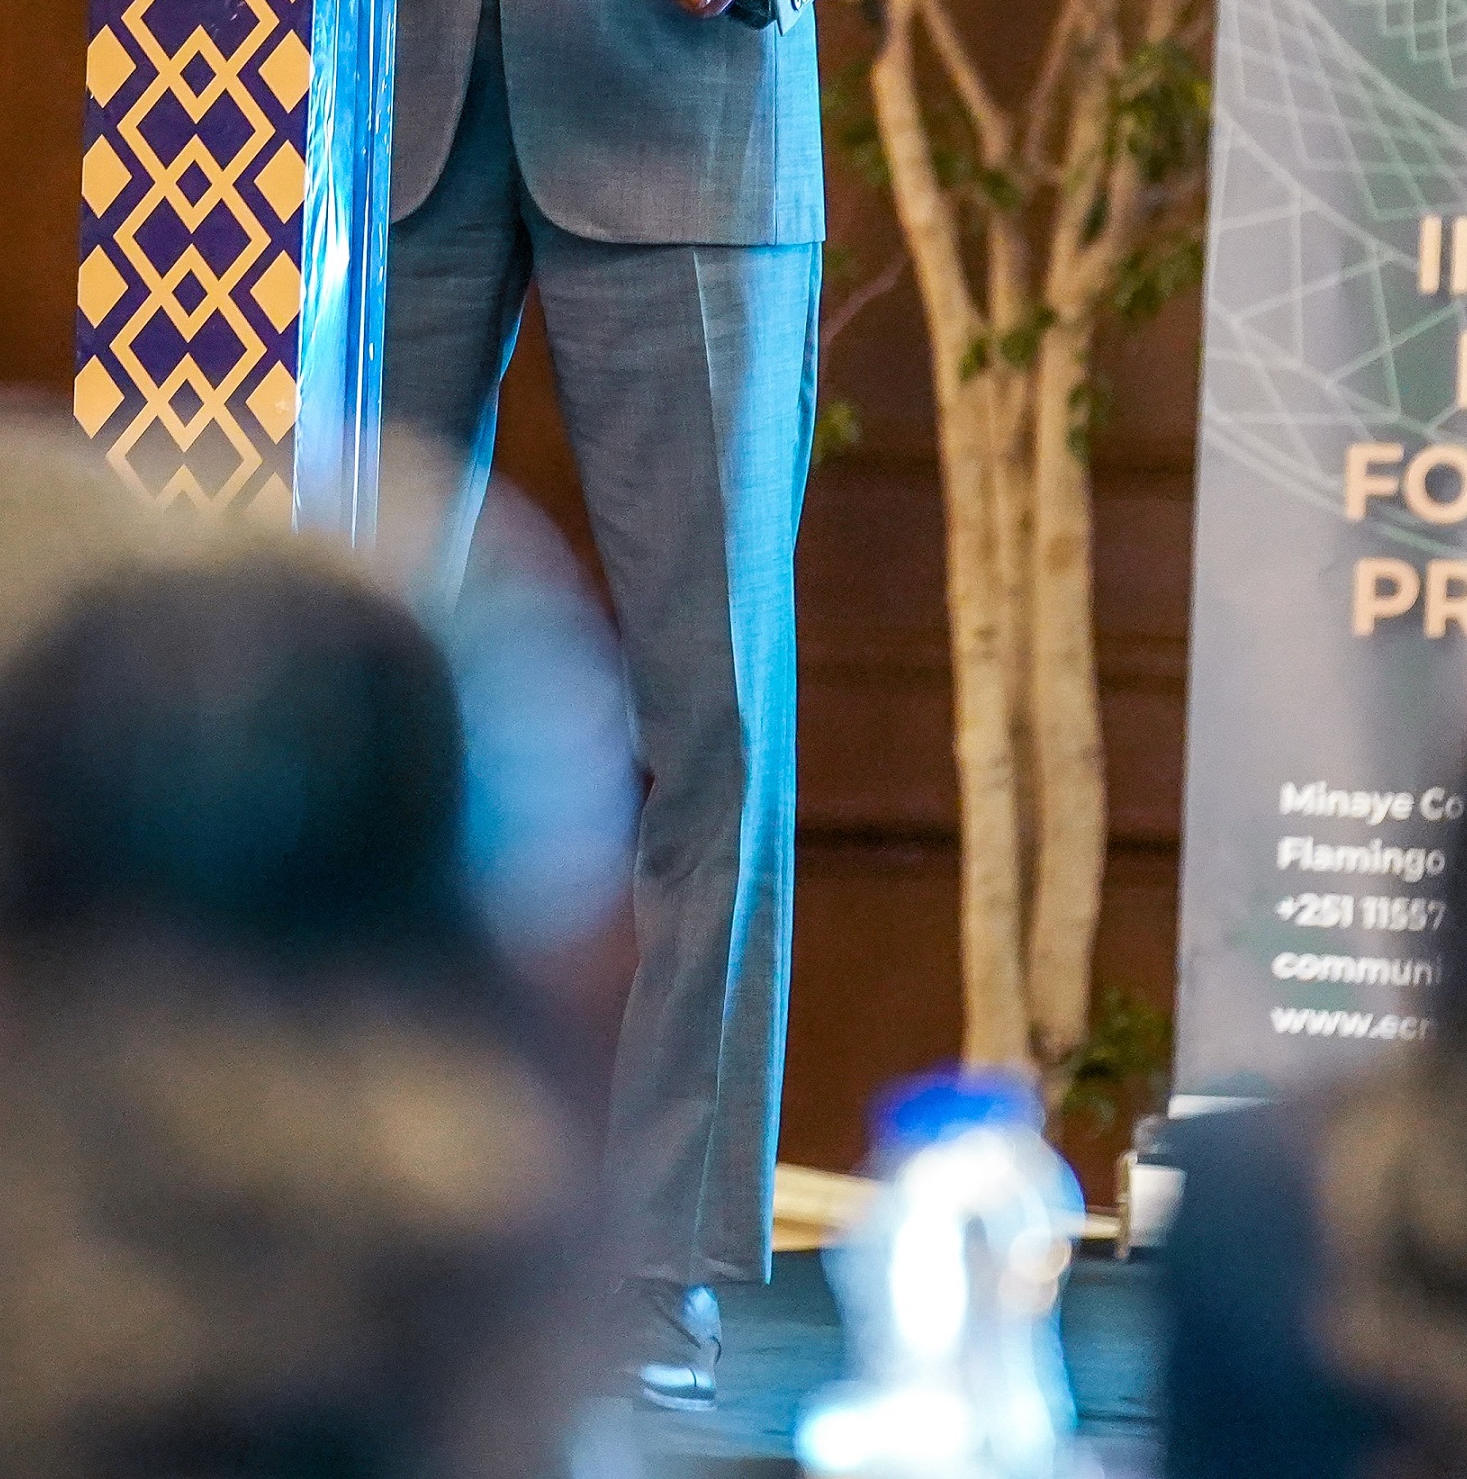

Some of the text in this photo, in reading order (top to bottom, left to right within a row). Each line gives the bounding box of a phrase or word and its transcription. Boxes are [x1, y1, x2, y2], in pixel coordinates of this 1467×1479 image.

[1278, 780, 1414, 825] Minaye
[1276, 835, 1447, 883] Flamingo
[1274, 892, 1354, 929] +251
